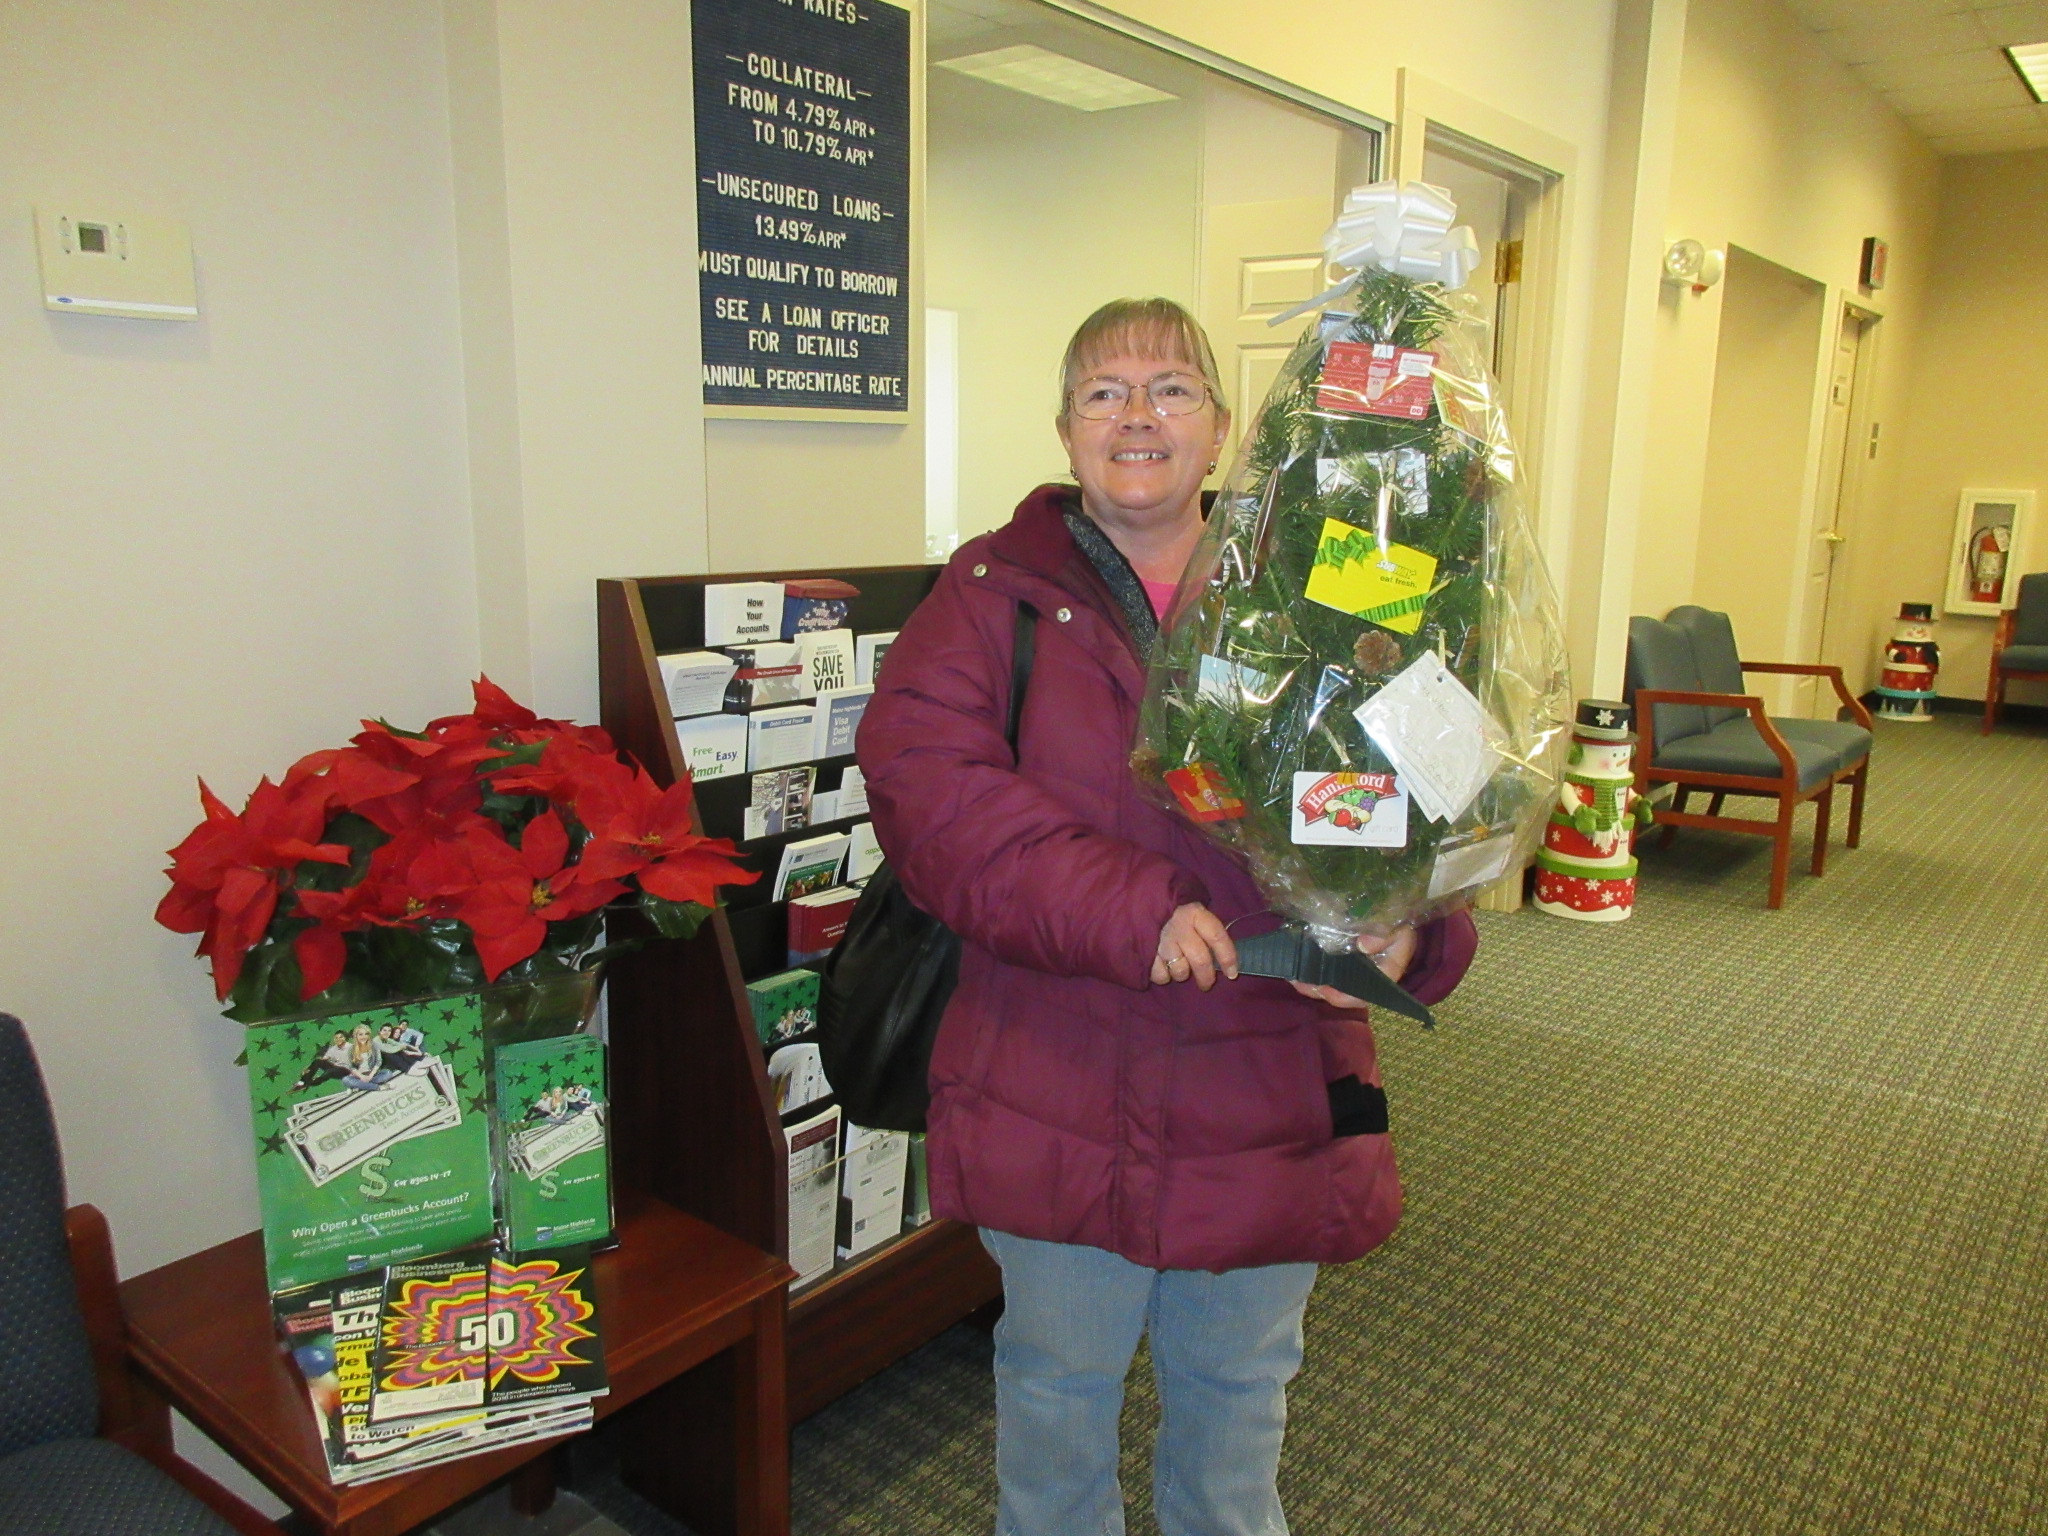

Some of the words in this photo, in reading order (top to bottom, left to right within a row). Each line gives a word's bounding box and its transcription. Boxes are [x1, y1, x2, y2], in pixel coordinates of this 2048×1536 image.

[728, 83, 778, 116] FROM
[785, 99, 841, 131] 4.79%
[753, 119, 775, 145] TO
[781, 126, 842, 160] 10.79%
[746, 257, 809, 286] QUALIFY
[815, 266, 834, 288] TO
[841, 270, 898, 297] BORROW
[715, 297, 749, 322] SEE
[761, 303, 772, 323] A
[783, 304, 822, 329] LOAN
[831, 310, 889, 336] OFFICER
[749, 330, 779, 353] FOR
[797, 334, 859, 359] DETAILS
[703, 364, 761, 389] ANNUAL
[767, 369, 862, 394] PERCENTAGE
[869, 375, 901, 397] RATE
[1376, 560, 1416, 579] SUBWAY
[747, 598, 763, 608] How
[747, 612, 762, 621] Your
[736, 624, 769, 634] Accounts
[813, 654, 844, 678] SAVE
[833, 726, 850, 736] Debit
[834, 716, 848, 726] Visa
[832, 735, 847, 746] Card
[693, 746, 713, 757] Free
[1306, 774, 1387, 810] Hannord
[318, 1086, 426, 1152] GREENBUCKS
[292, 1226, 317, 1238] Why
[320, 1220, 348, 1232] Open
[351, 1218, 357, 1226] a
[361, 1204, 419, 1223] Greenbucks
[422, 1192, 469, 1210] Account?
[391, 1262, 465, 1272] Bloomberg
[335, 1331, 362, 1341] con
[460, 1312, 514, 1351] 50
[369, 1426, 415, 1439] Watch
